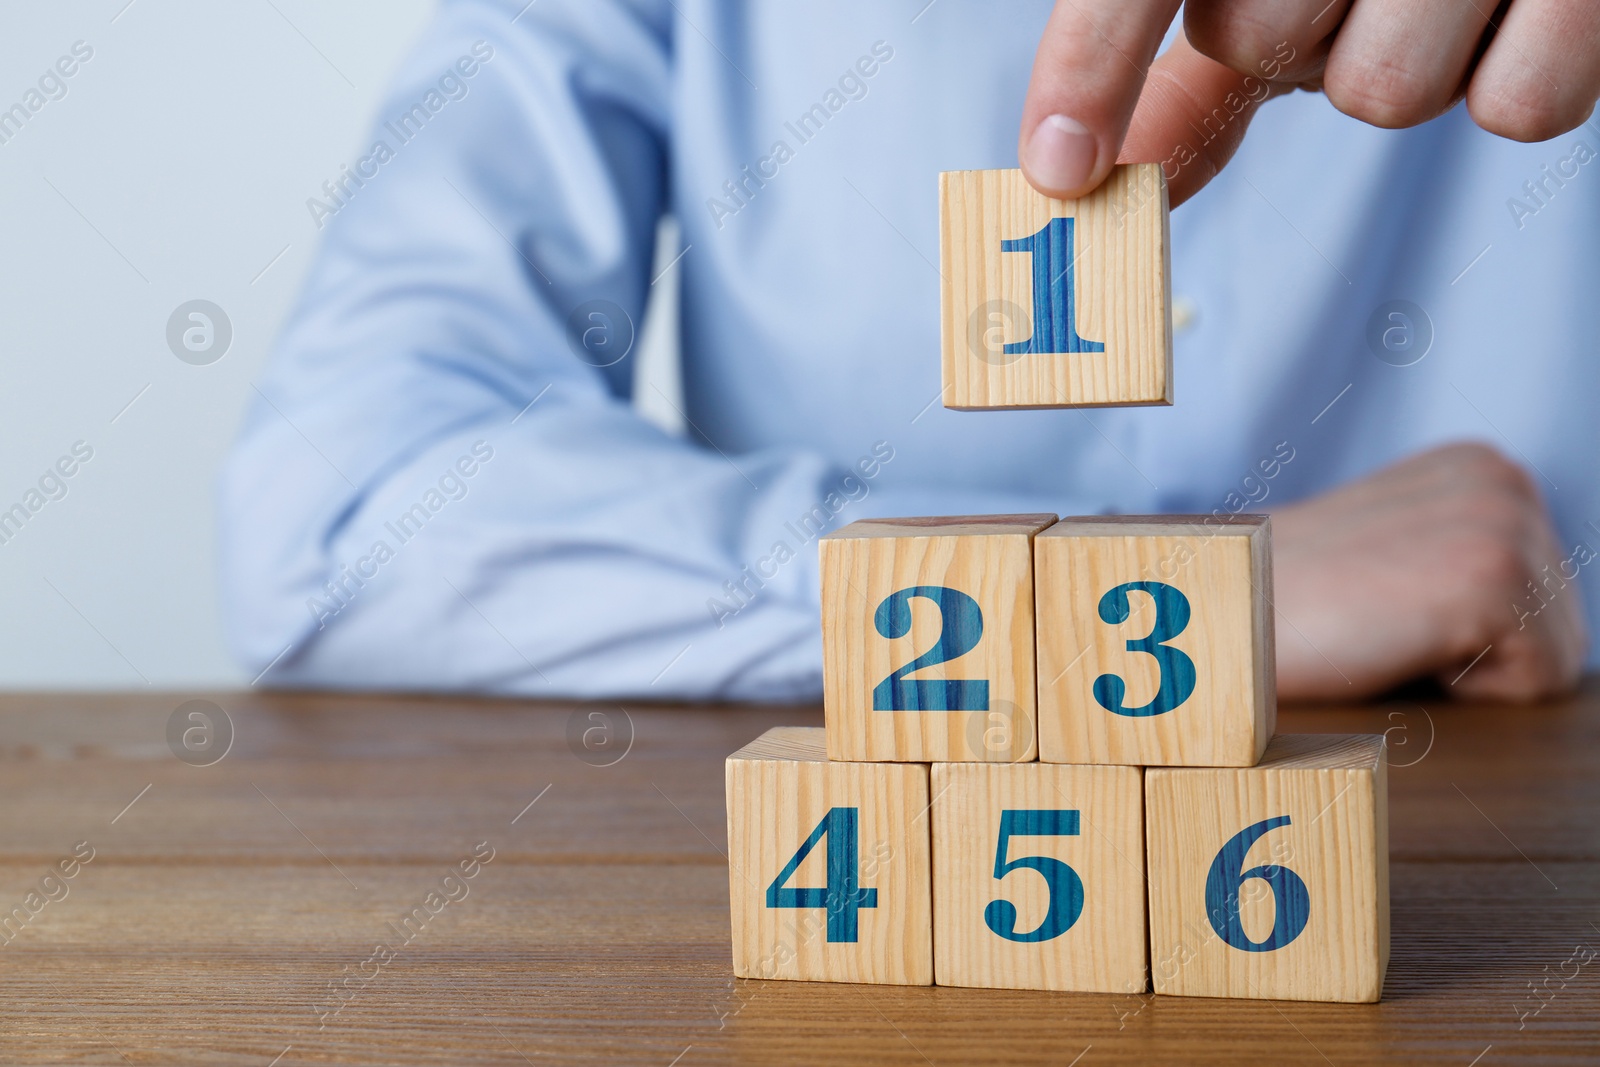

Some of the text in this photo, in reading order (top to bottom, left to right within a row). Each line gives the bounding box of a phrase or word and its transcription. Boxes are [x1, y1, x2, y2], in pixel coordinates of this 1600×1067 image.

[1003, 218, 1105, 354] 1
[873, 586, 989, 711] 2
[1093, 582, 1196, 717] 3
[766, 808, 877, 943] 4
[984, 810, 1084, 943] 5
[1205, 815, 1310, 952] 6
